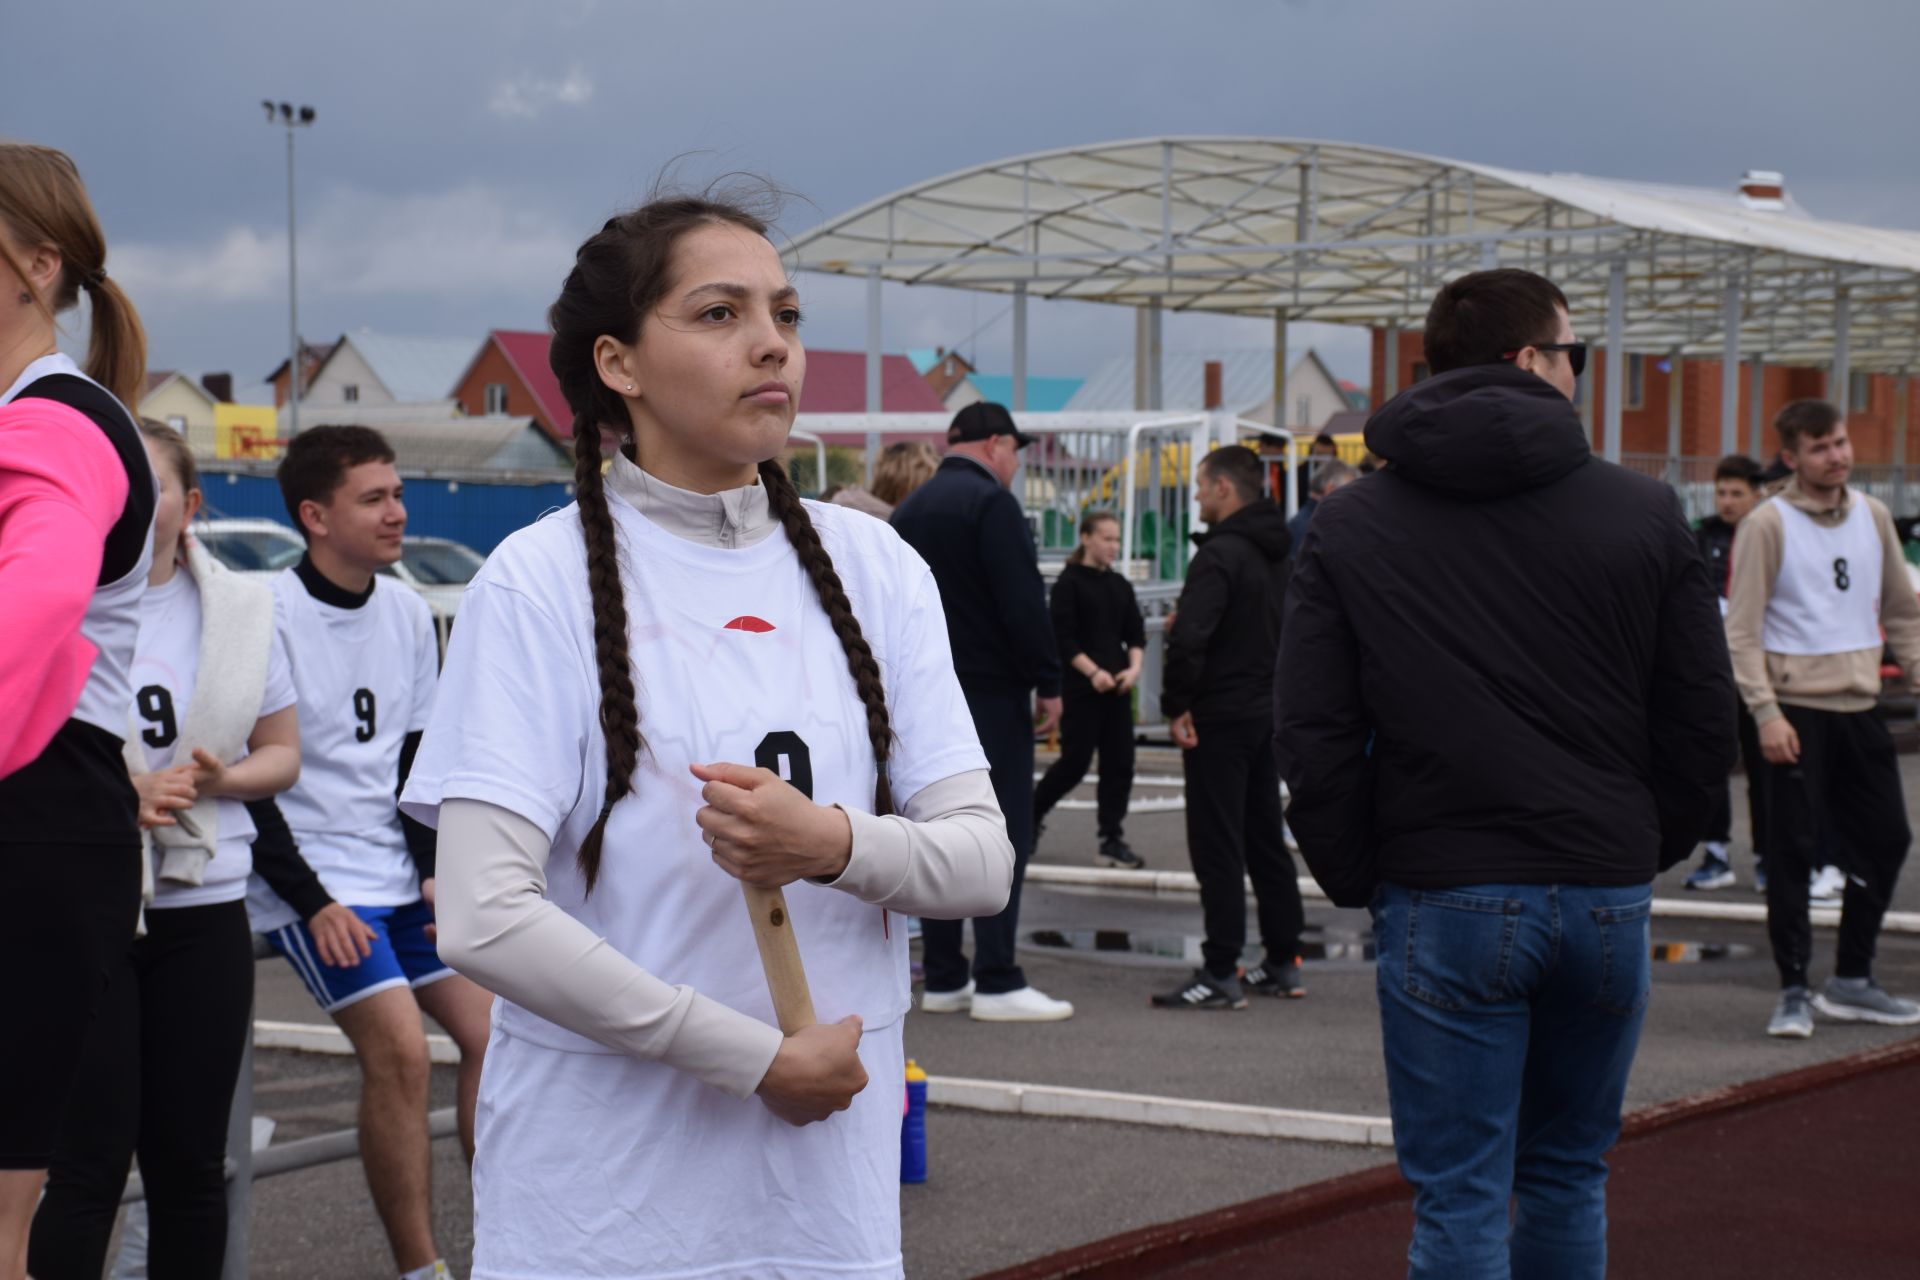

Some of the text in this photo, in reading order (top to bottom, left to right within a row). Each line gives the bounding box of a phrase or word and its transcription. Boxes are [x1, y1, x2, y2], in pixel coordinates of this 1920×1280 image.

[1834, 557, 1850, 591] 8
[136, 685, 178, 749] 9
[353, 688, 376, 743] 9
